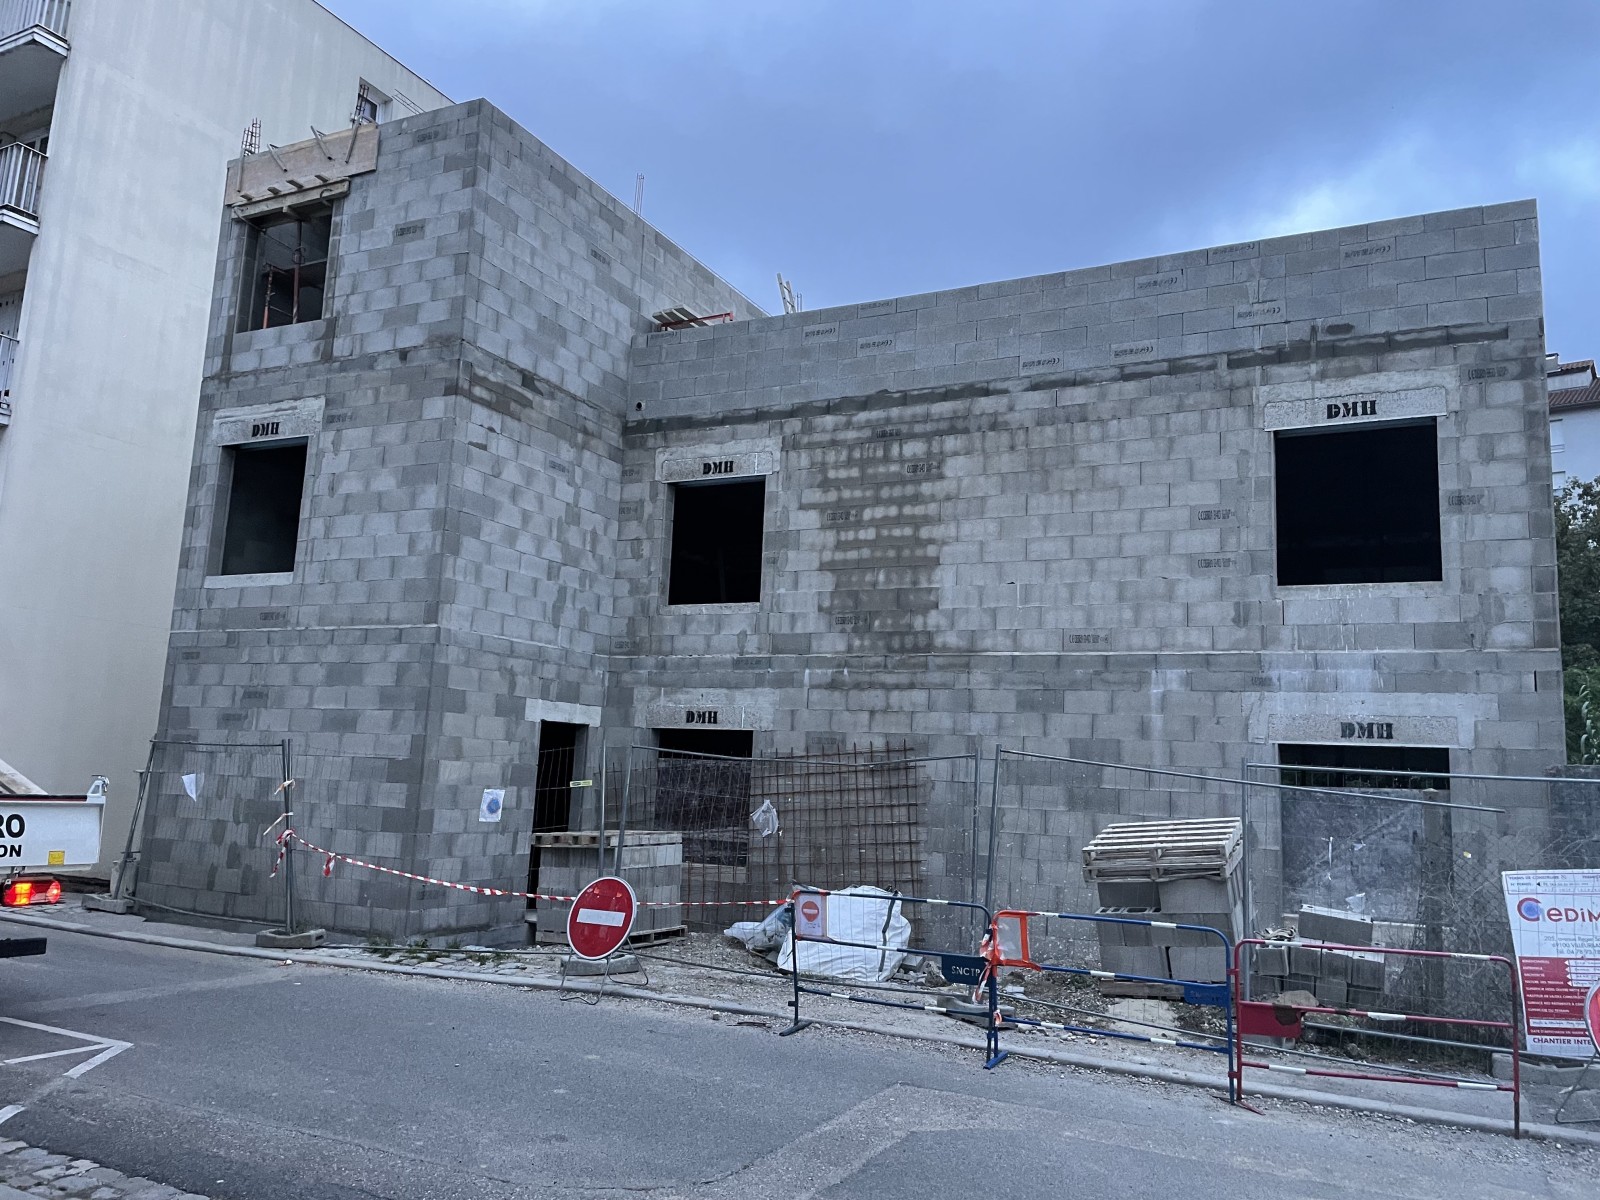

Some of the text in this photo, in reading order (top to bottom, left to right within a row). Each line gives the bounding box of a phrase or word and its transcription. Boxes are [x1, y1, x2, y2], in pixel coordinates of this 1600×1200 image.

[1327, 400, 1378, 420] DMH
[251, 421, 280, 437] DMH
[702, 460, 734, 475] DMH
[686, 710, 718, 725] DMH
[1340, 722, 1393, 740] DMH
[1532, 1037, 1572, 1045] CHANTIER
